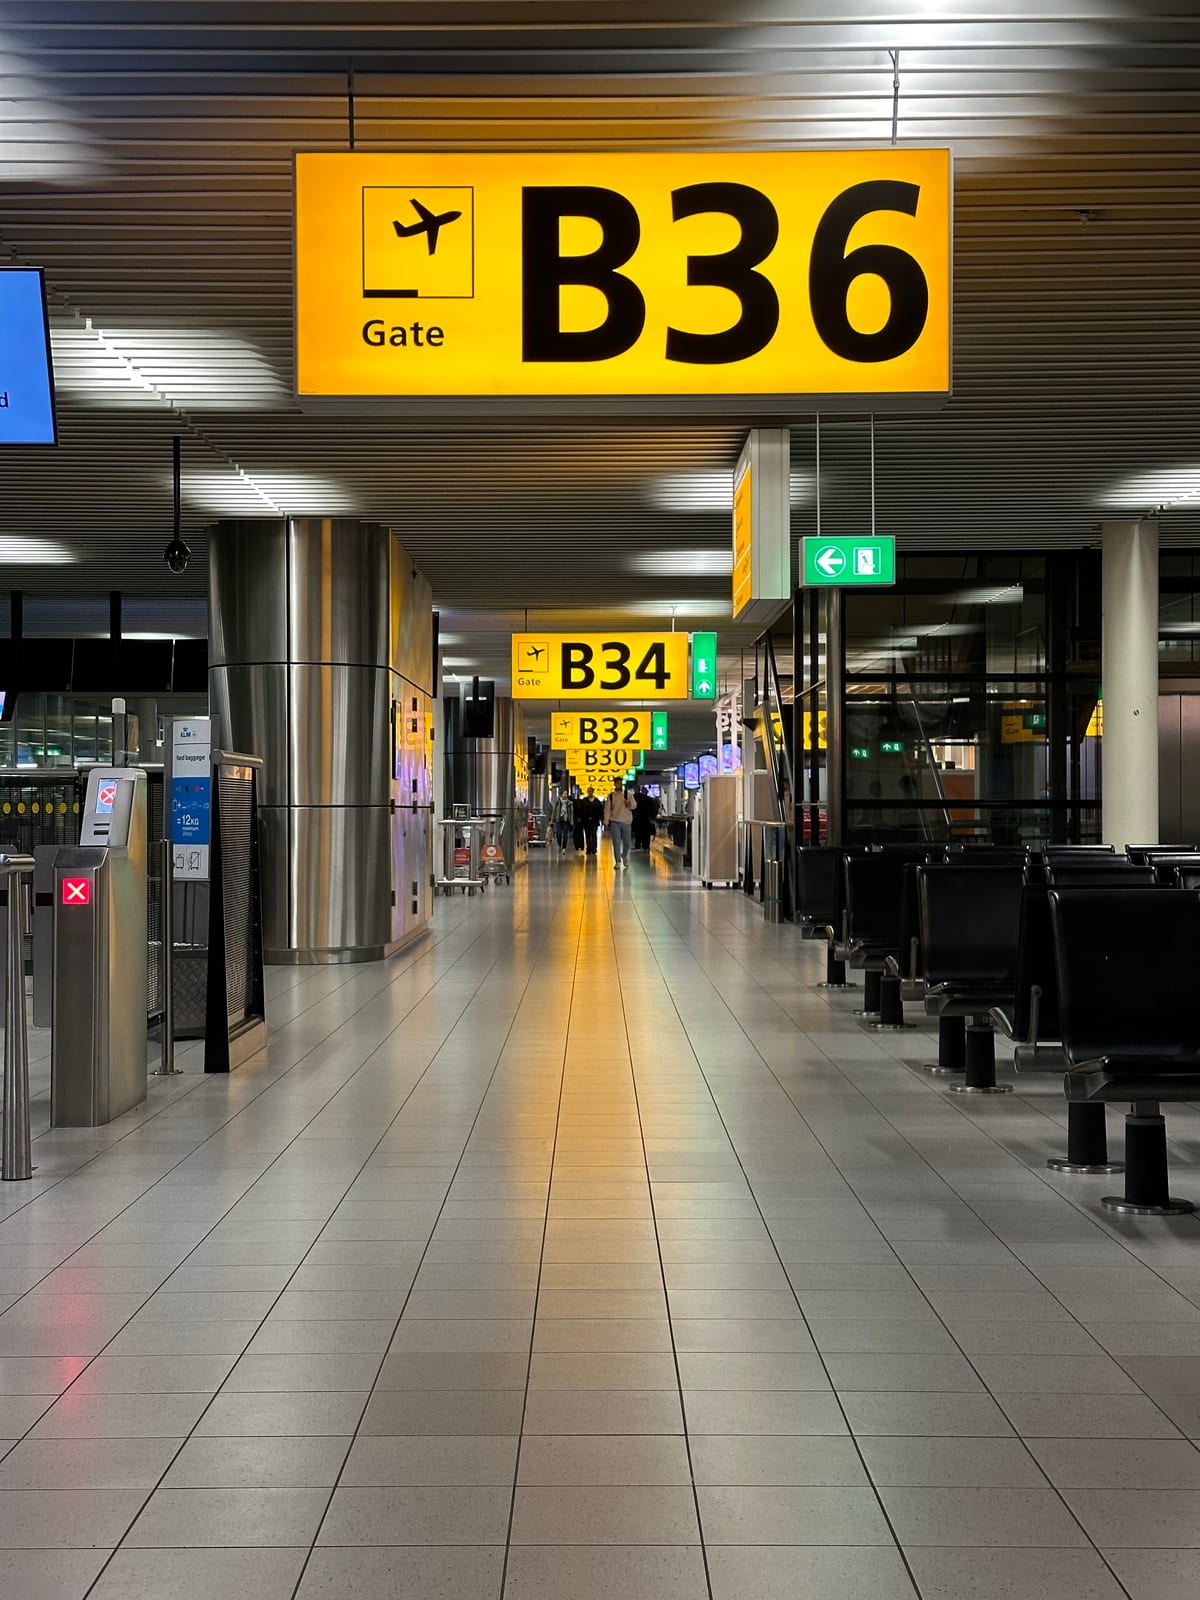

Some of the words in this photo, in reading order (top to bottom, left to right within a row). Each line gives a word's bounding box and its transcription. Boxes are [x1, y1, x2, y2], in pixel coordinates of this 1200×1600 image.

[522, 179, 929, 365] B36
[362, 319, 445, 348] Gate
[561, 642, 671, 690] B34
[517, 677, 541, 686] Gate
[579, 717, 640, 745] B32
[585, 749, 627, 766] B30
